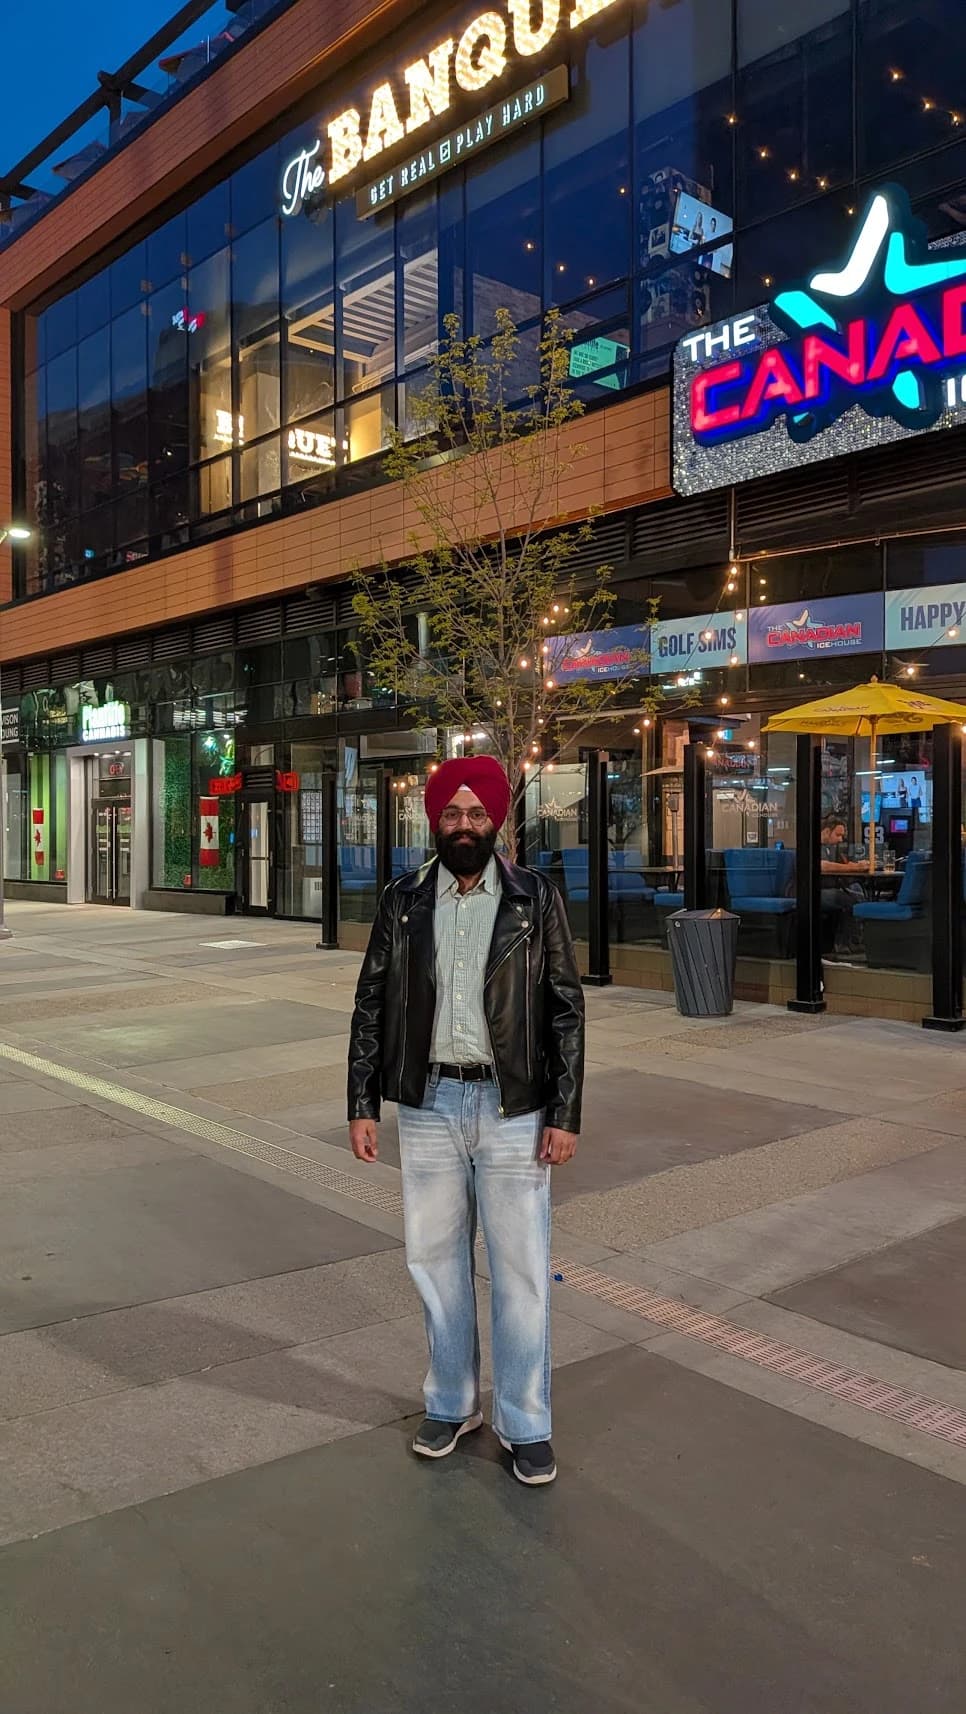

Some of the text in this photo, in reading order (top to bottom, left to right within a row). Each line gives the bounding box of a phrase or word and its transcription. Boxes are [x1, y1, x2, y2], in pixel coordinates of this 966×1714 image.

[369, 84, 544, 205] GET REAL PLAY HARD
[282, 140, 325, 216] The
[682, 315, 756, 362] THE
[767, 624, 783, 632] THE
[900, 601, 966, 631] HAPPY
[658, 633, 695, 657] GOLF
[698, 627, 736, 653] SIMS
[767, 622, 862, 647] CANADIAN
[816, 639, 862, 649] ICEHOUSE
[82, 725, 126, 742] CANNABIS
[536, 807, 578, 817] CANADIAN
[721, 802, 778, 814] CANADIAN
